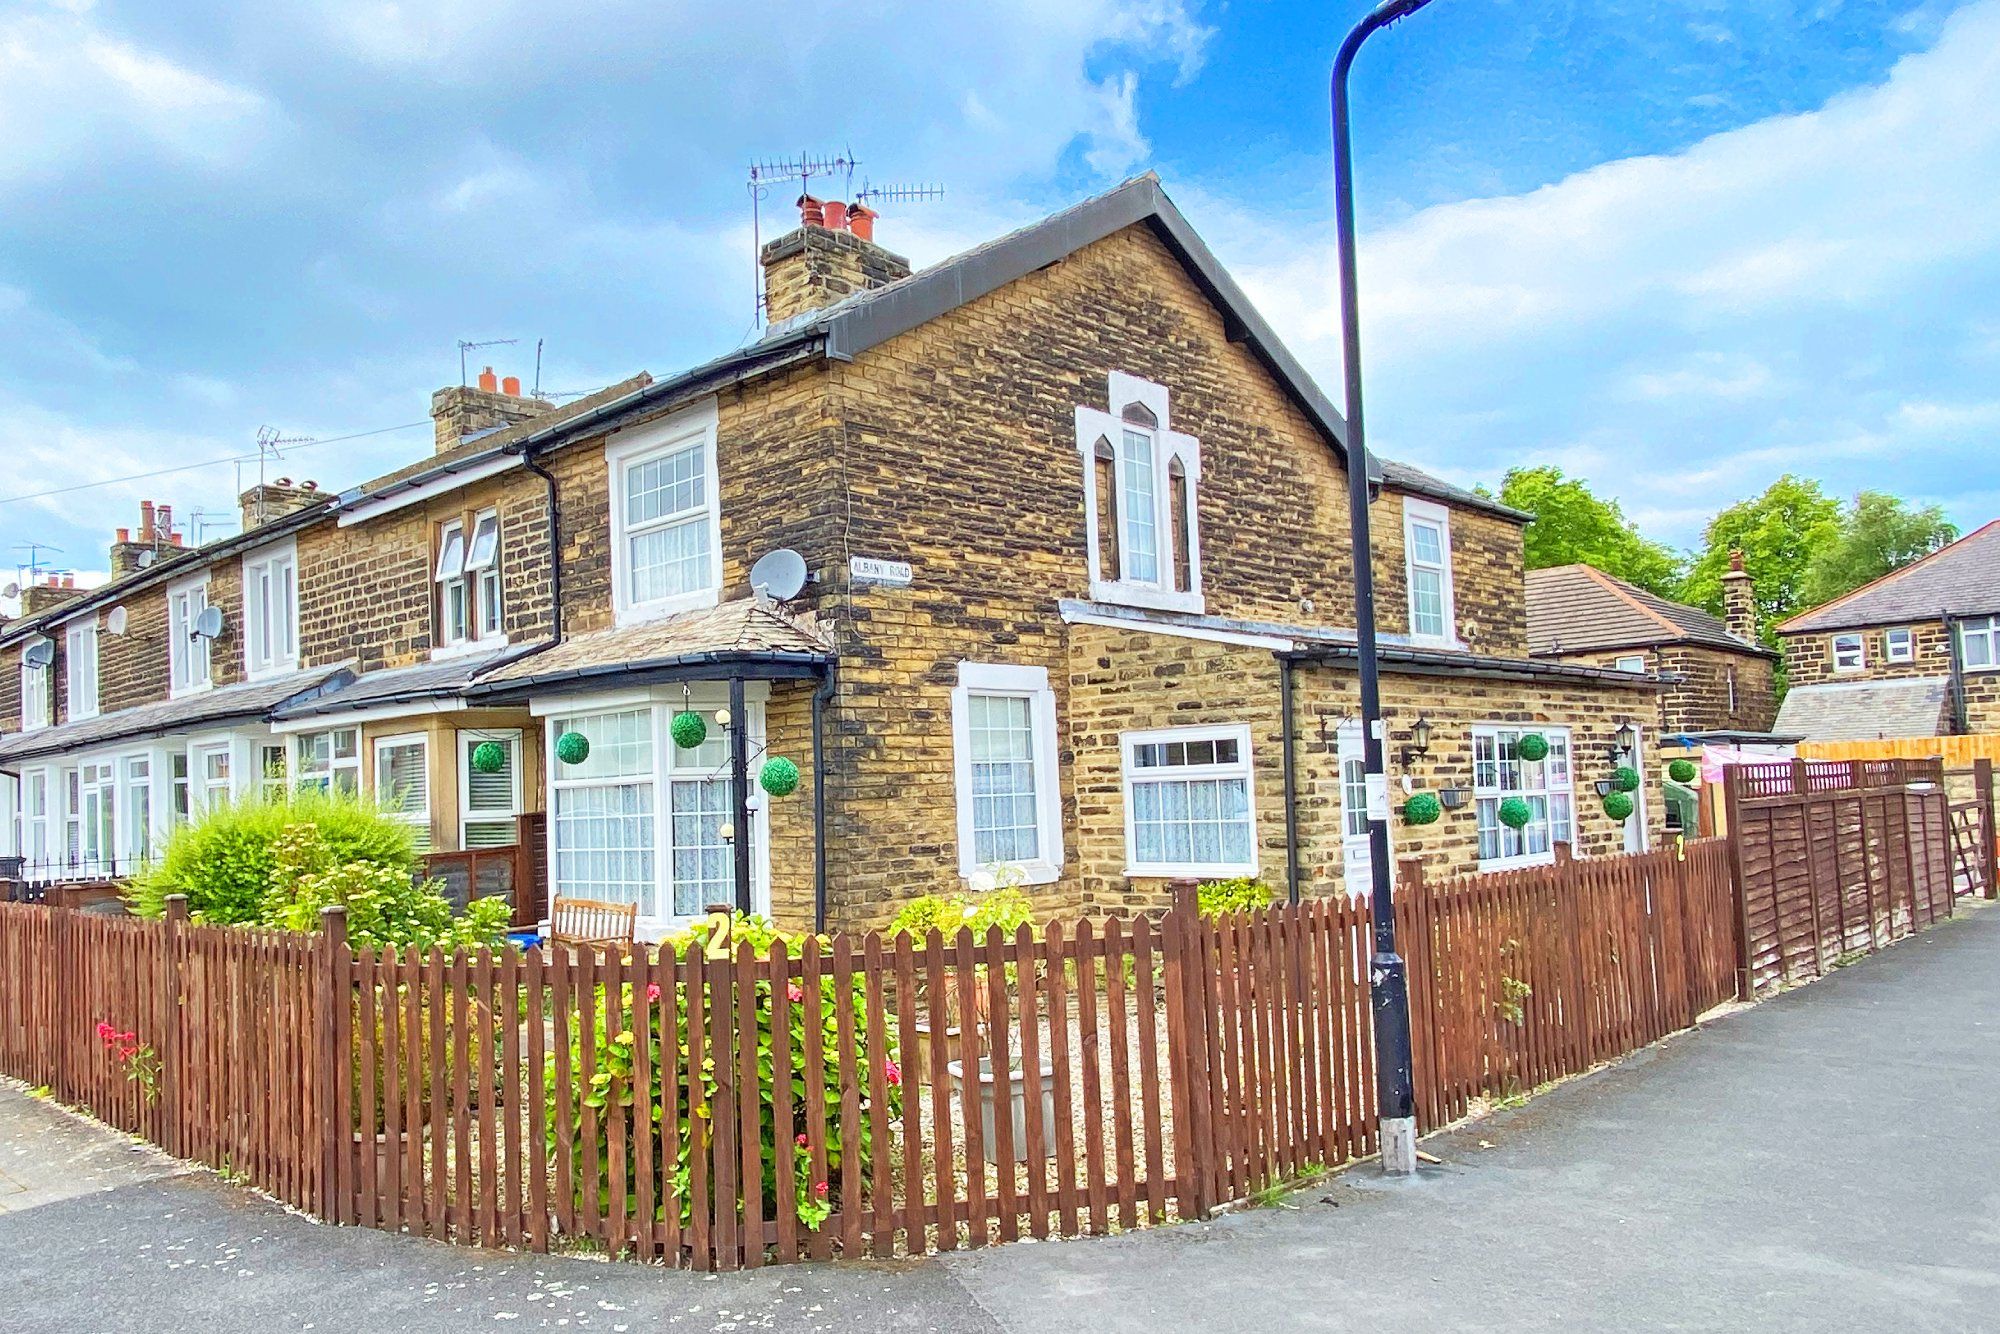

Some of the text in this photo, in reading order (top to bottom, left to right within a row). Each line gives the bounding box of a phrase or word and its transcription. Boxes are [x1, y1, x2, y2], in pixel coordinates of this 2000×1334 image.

[853, 560, 910, 578] ALBANY ROAD
[705, 912, 730, 960] 2
